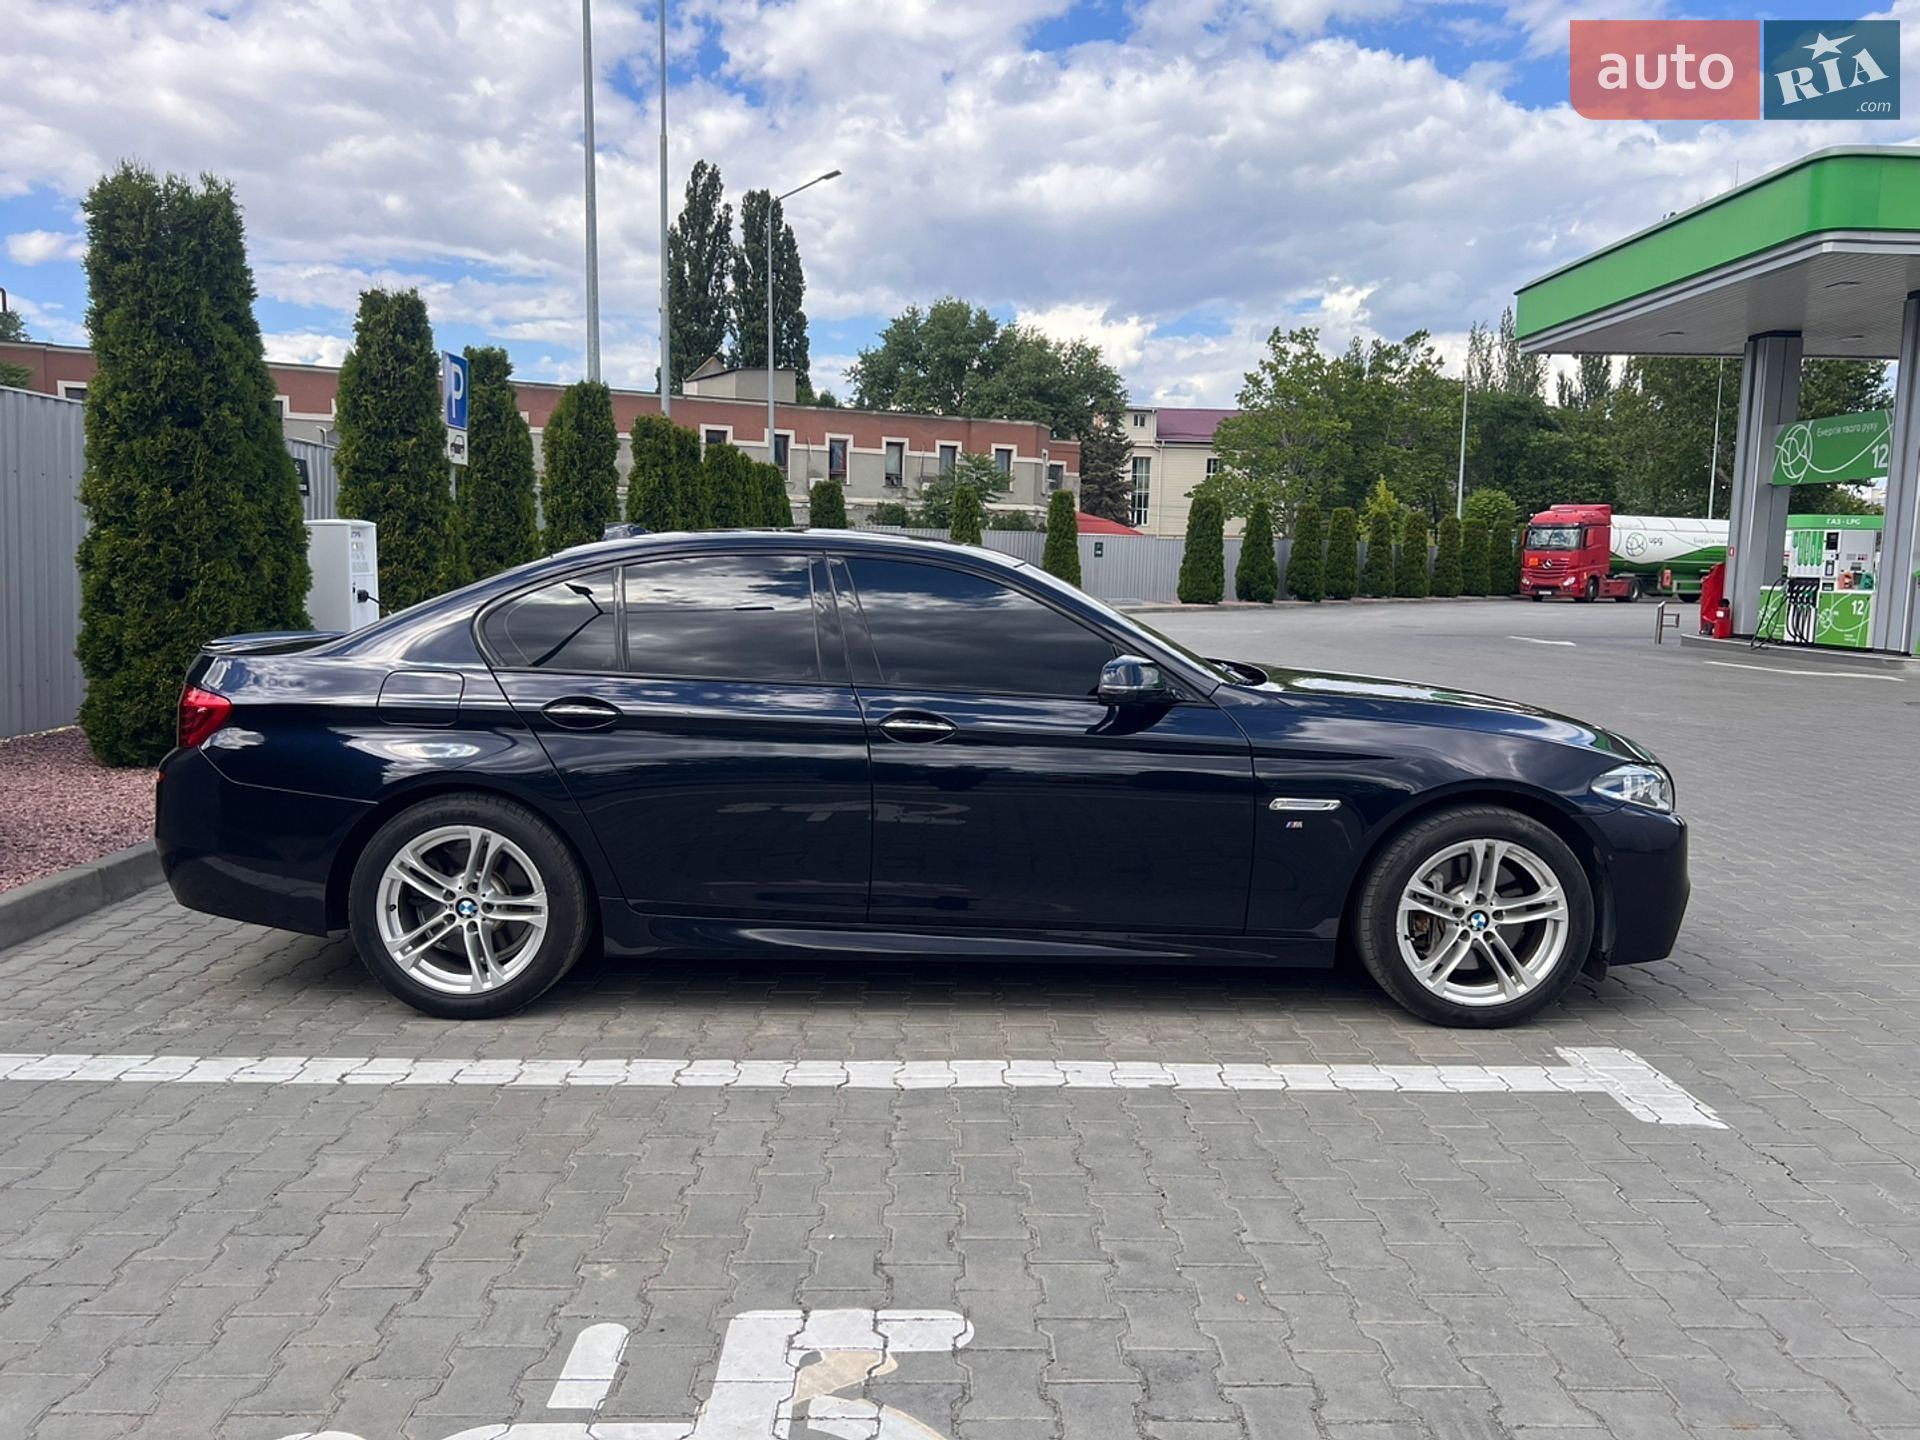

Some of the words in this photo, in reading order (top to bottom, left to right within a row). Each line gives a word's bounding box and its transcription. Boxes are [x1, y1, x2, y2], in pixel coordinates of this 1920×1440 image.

[451, 362, 464, 419] P
[1872, 443, 1889, 469] 12
[1851, 599, 1864, 615] 12
